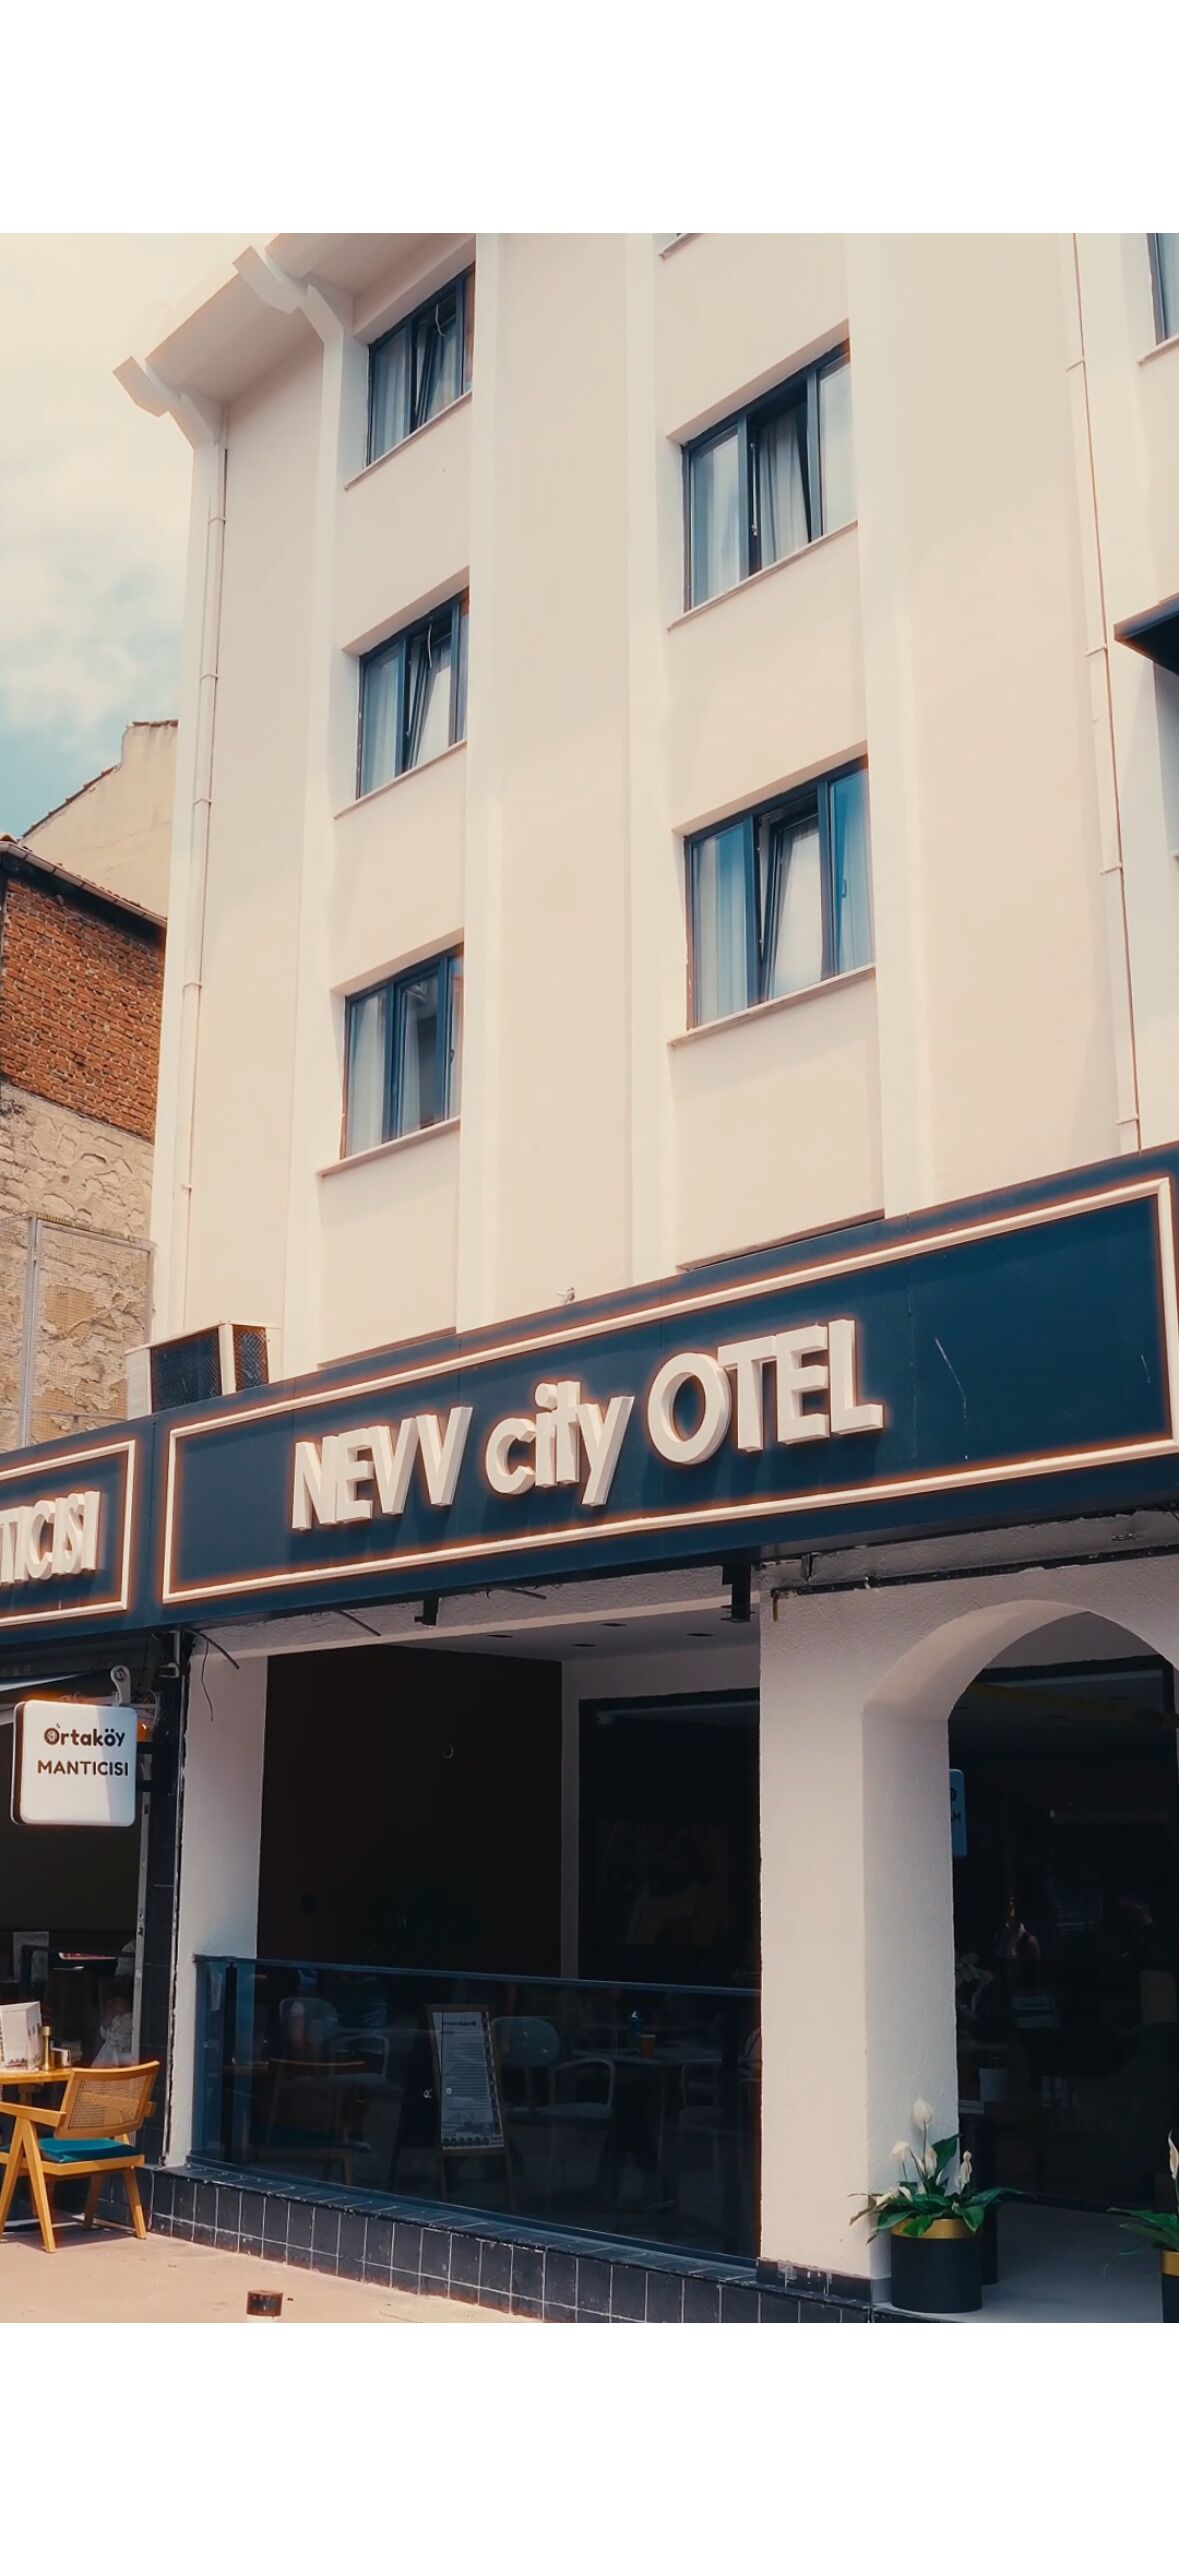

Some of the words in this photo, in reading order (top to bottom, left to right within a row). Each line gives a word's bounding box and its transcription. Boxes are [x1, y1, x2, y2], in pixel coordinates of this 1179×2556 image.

[485, 1381, 635, 1506] city
[647, 1319, 884, 1465] OTEL
[44, 1724, 126, 1748] Ortaköy
[37, 1759, 129, 1777] MANTICISI
